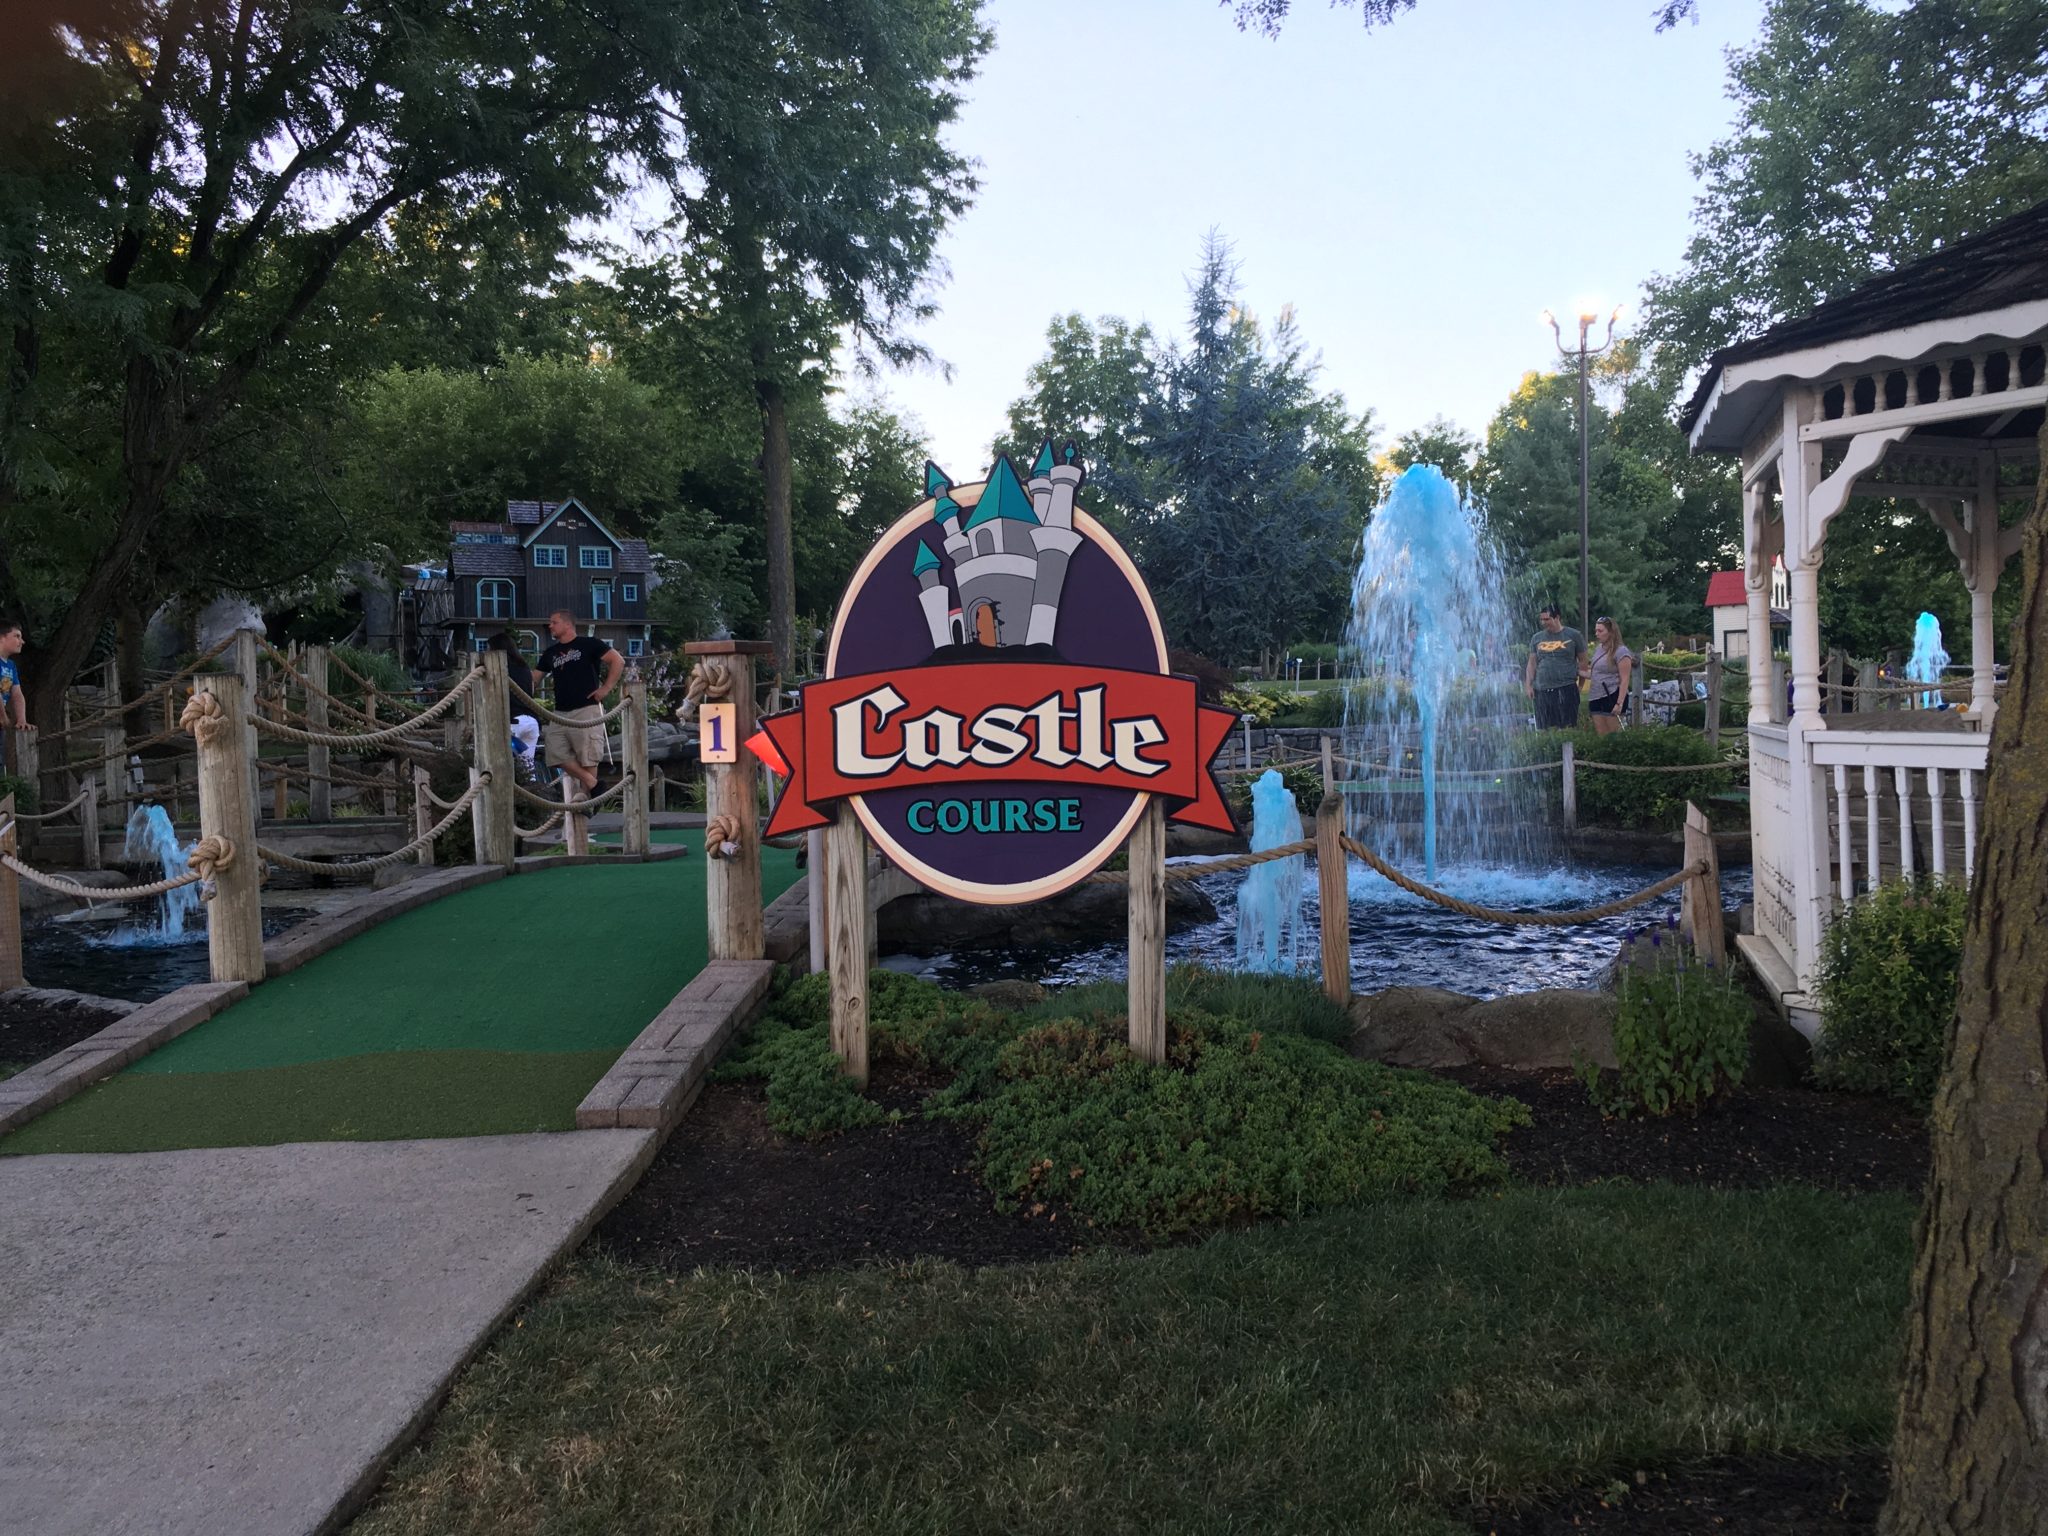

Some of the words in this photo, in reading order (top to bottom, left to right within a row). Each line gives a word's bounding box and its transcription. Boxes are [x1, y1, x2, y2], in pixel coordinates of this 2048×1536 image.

[707, 714, 727, 752] 1
[832, 684, 1170, 777] Castle
[906, 798, 1083, 834] COURSE
